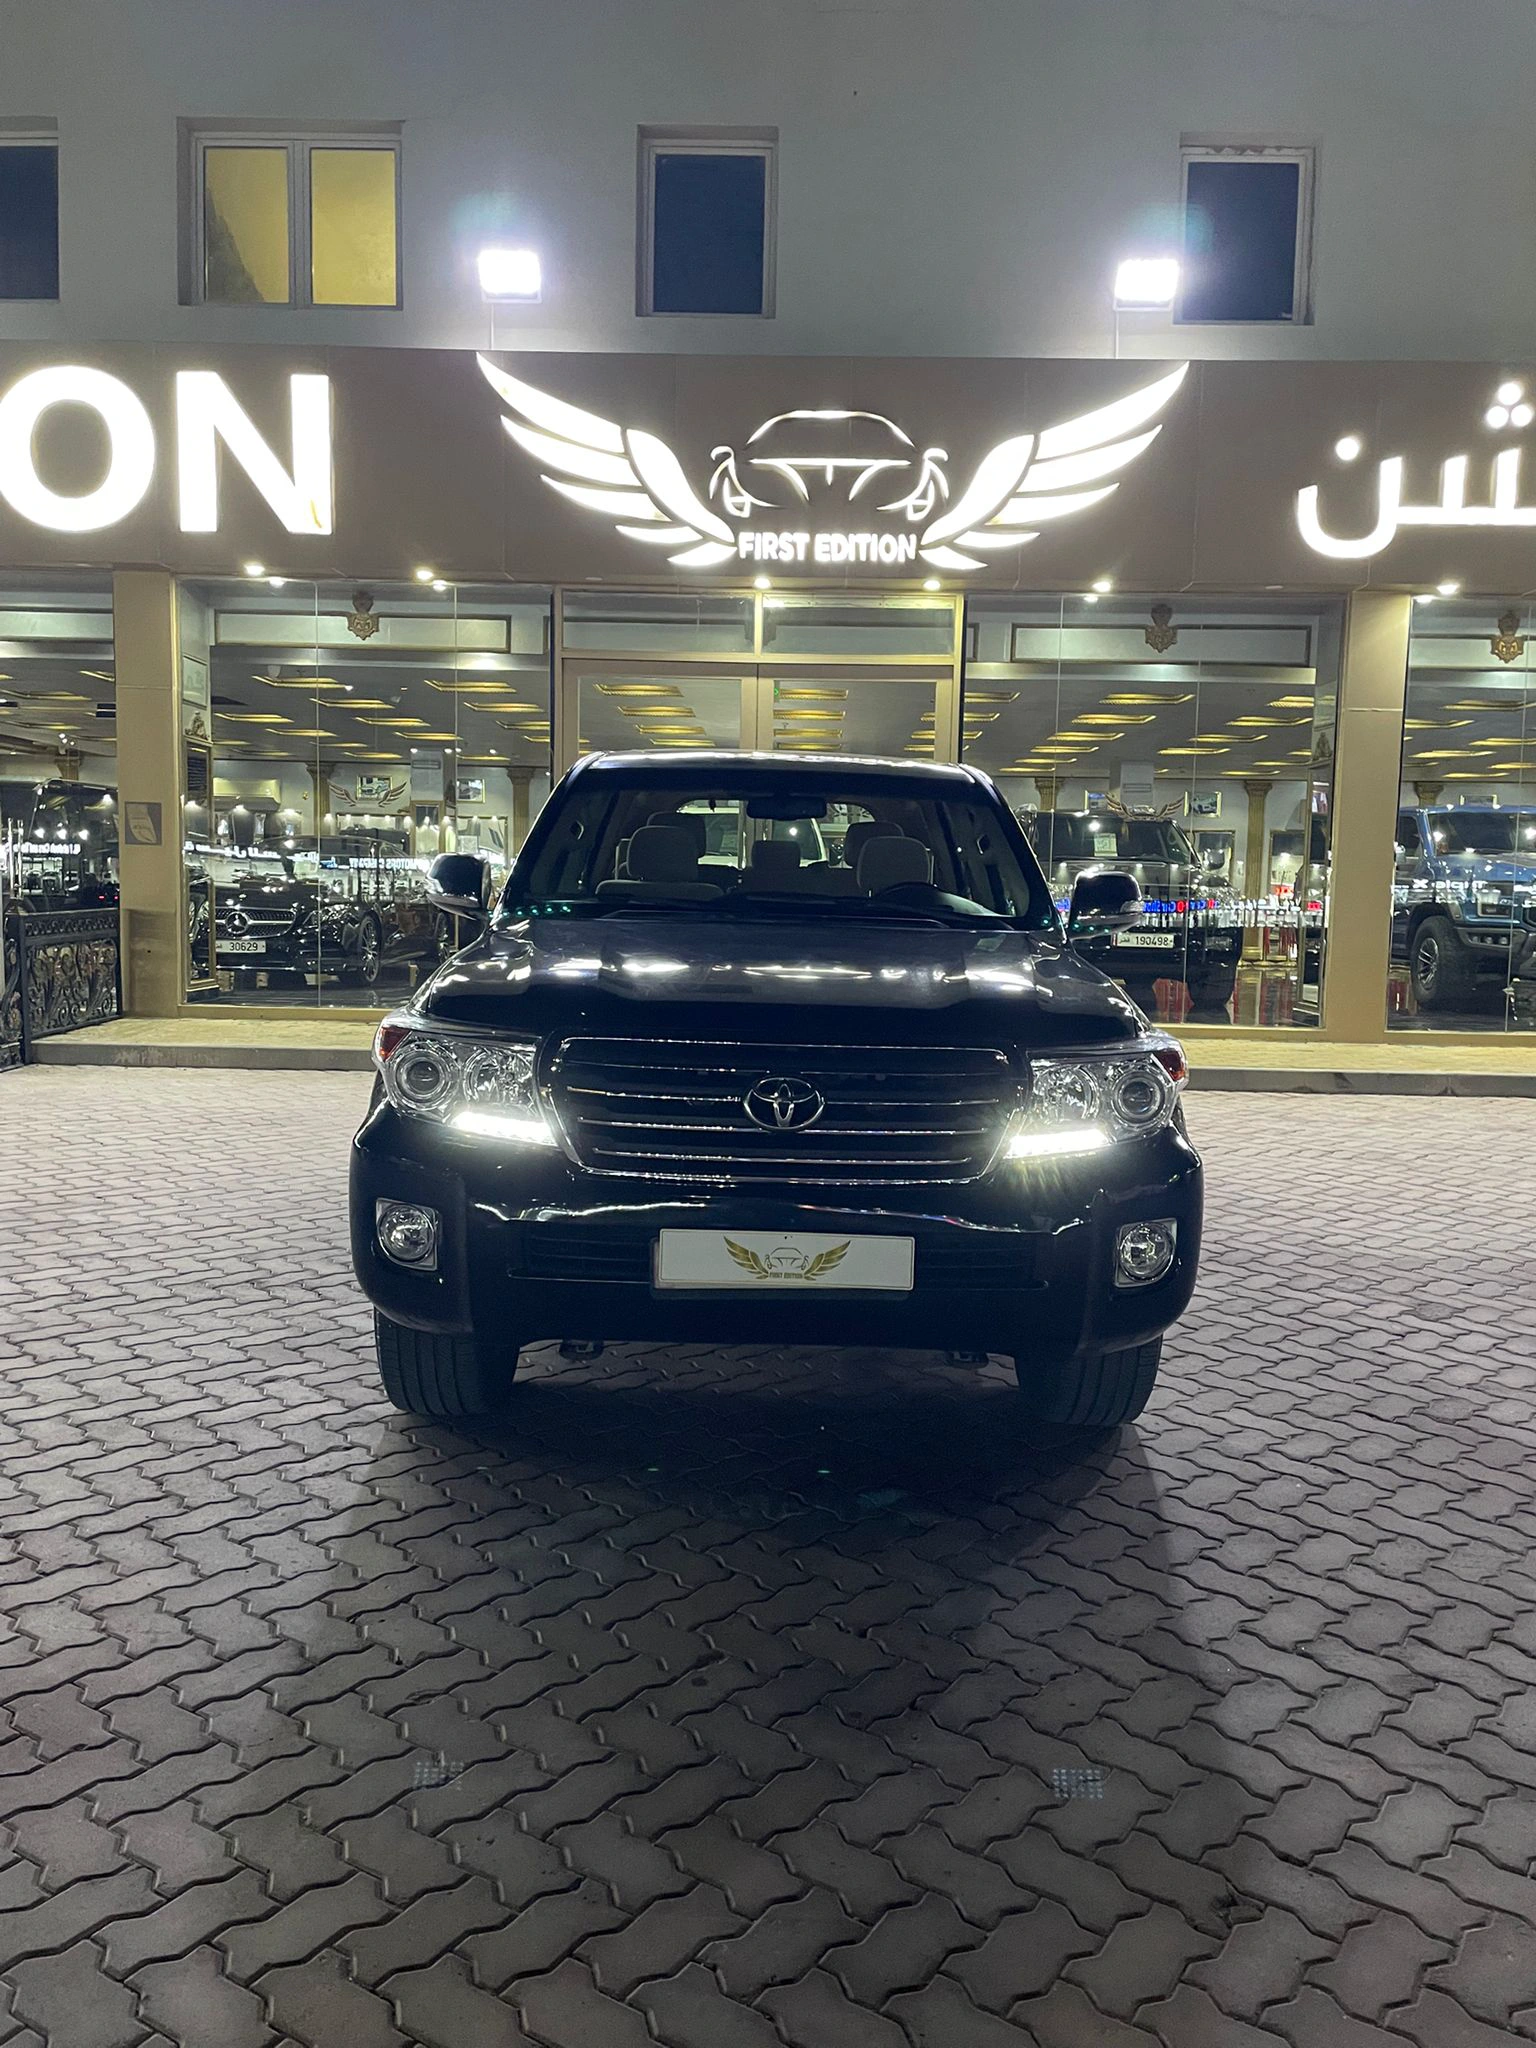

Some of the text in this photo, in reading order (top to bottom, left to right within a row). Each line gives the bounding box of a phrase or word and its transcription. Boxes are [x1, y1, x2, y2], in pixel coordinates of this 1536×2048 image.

[0, 365, 334, 535] ON
[738, 531, 917, 563] FIRST EDITION
[229, 942, 258, 951] 30629
[1135, 936, 1169, 946] 190498
